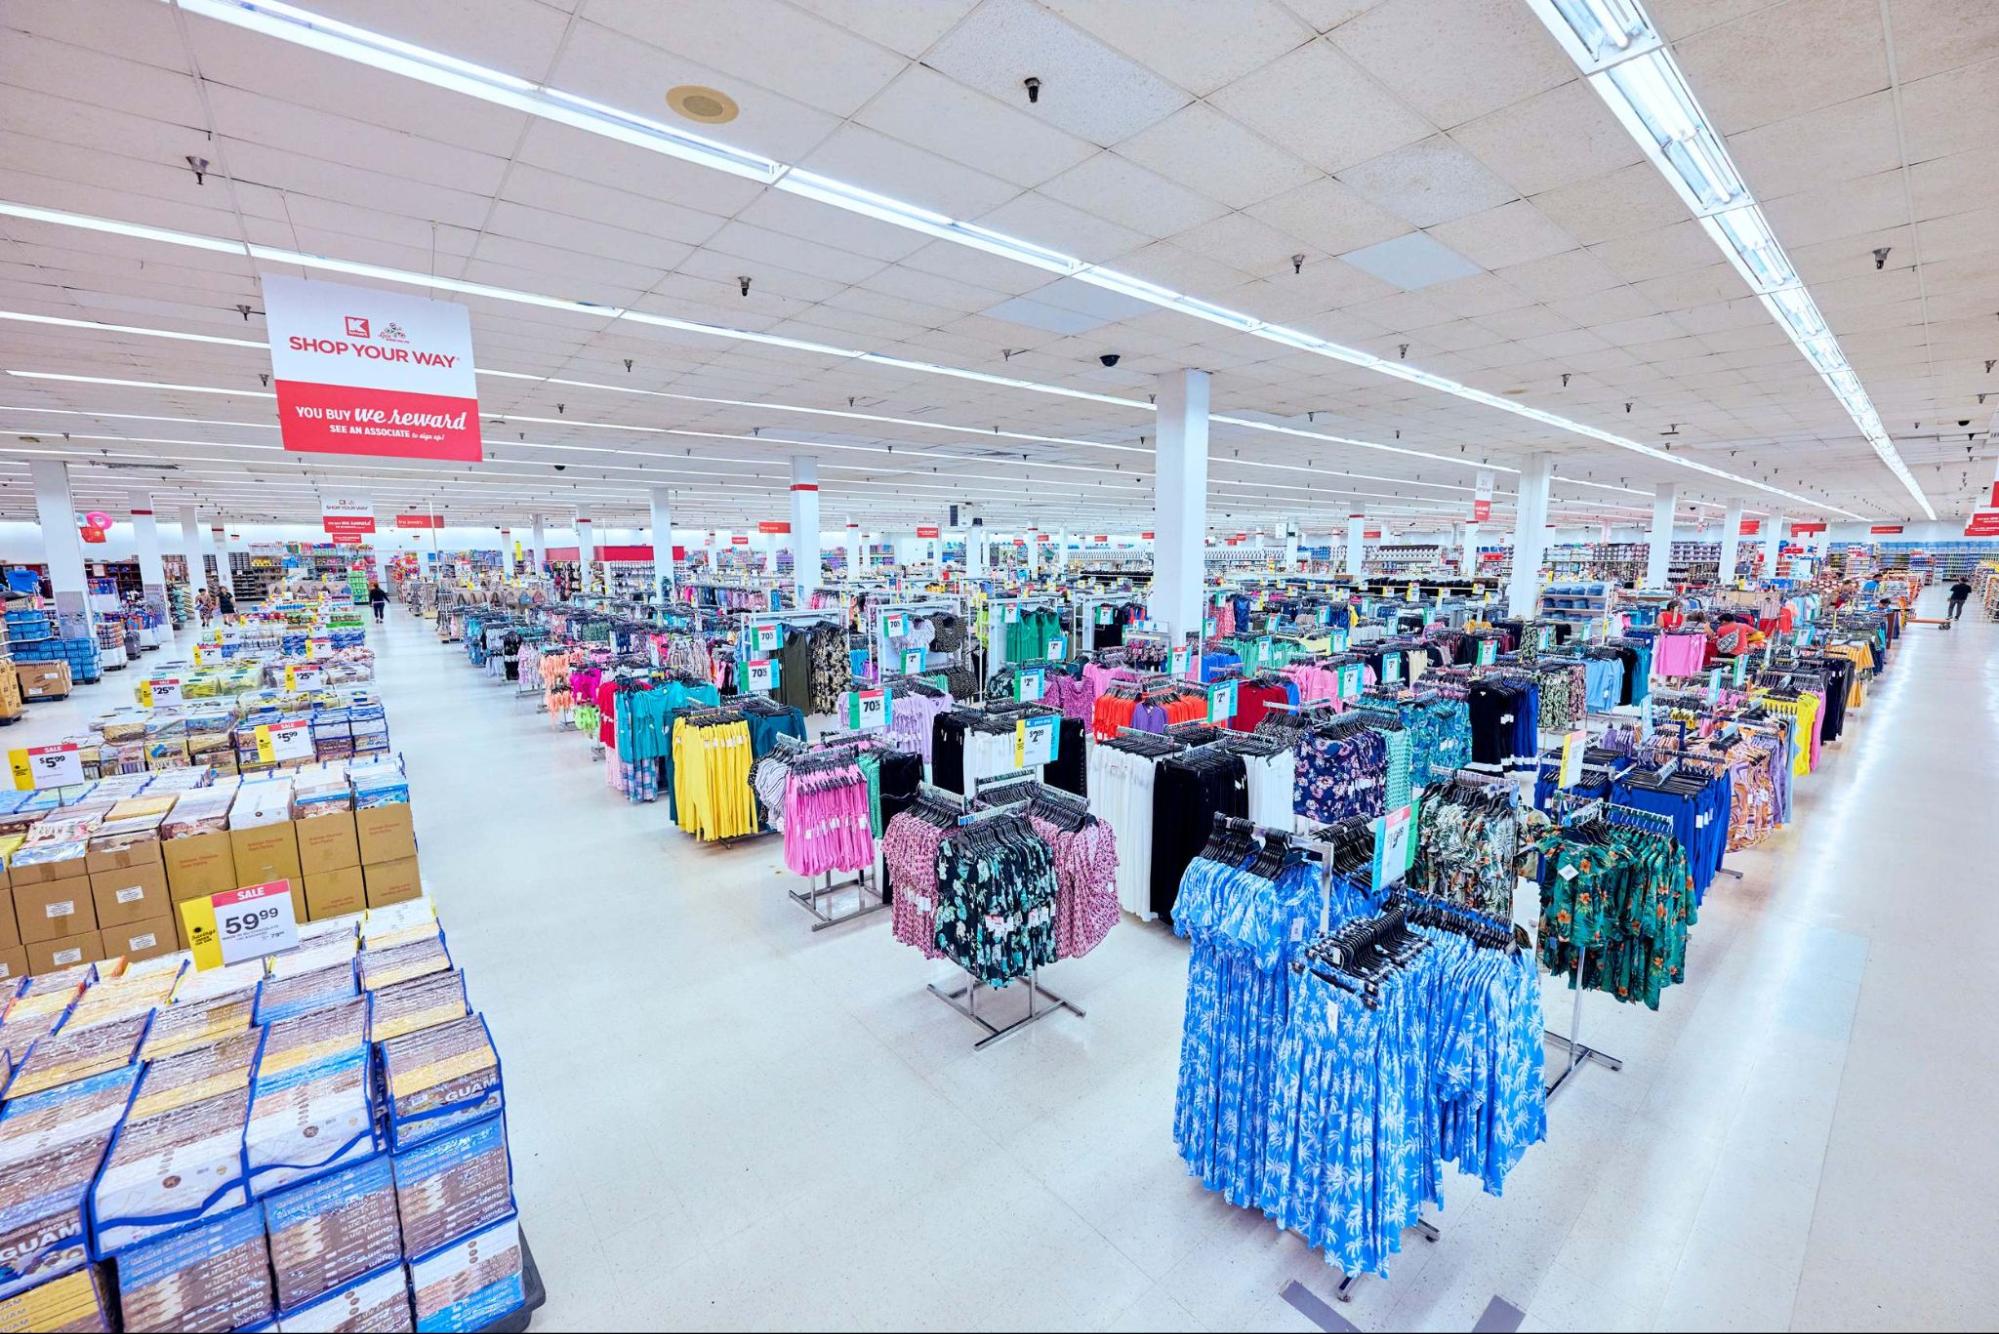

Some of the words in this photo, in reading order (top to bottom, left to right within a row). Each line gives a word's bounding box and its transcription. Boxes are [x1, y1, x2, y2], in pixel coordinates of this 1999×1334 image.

[289, 335, 348, 355] SHOP
[352, 343, 409, 362] YOUR
[412, 351, 455, 368] WAY
[296, 406, 322, 419] YOU
[326, 408, 351, 421] BUY
[354, 408, 386, 424] we
[388, 409, 467, 431] reward
[329, 424, 347, 433] SEE
[349, 426, 362, 435] AN
[364, 428, 410, 438] ASSOCIATE
[237, 887, 265, 900] SALE
[445, 1077, 497, 1102] GUAM
[0, 1222, 81, 1260] GUAM
